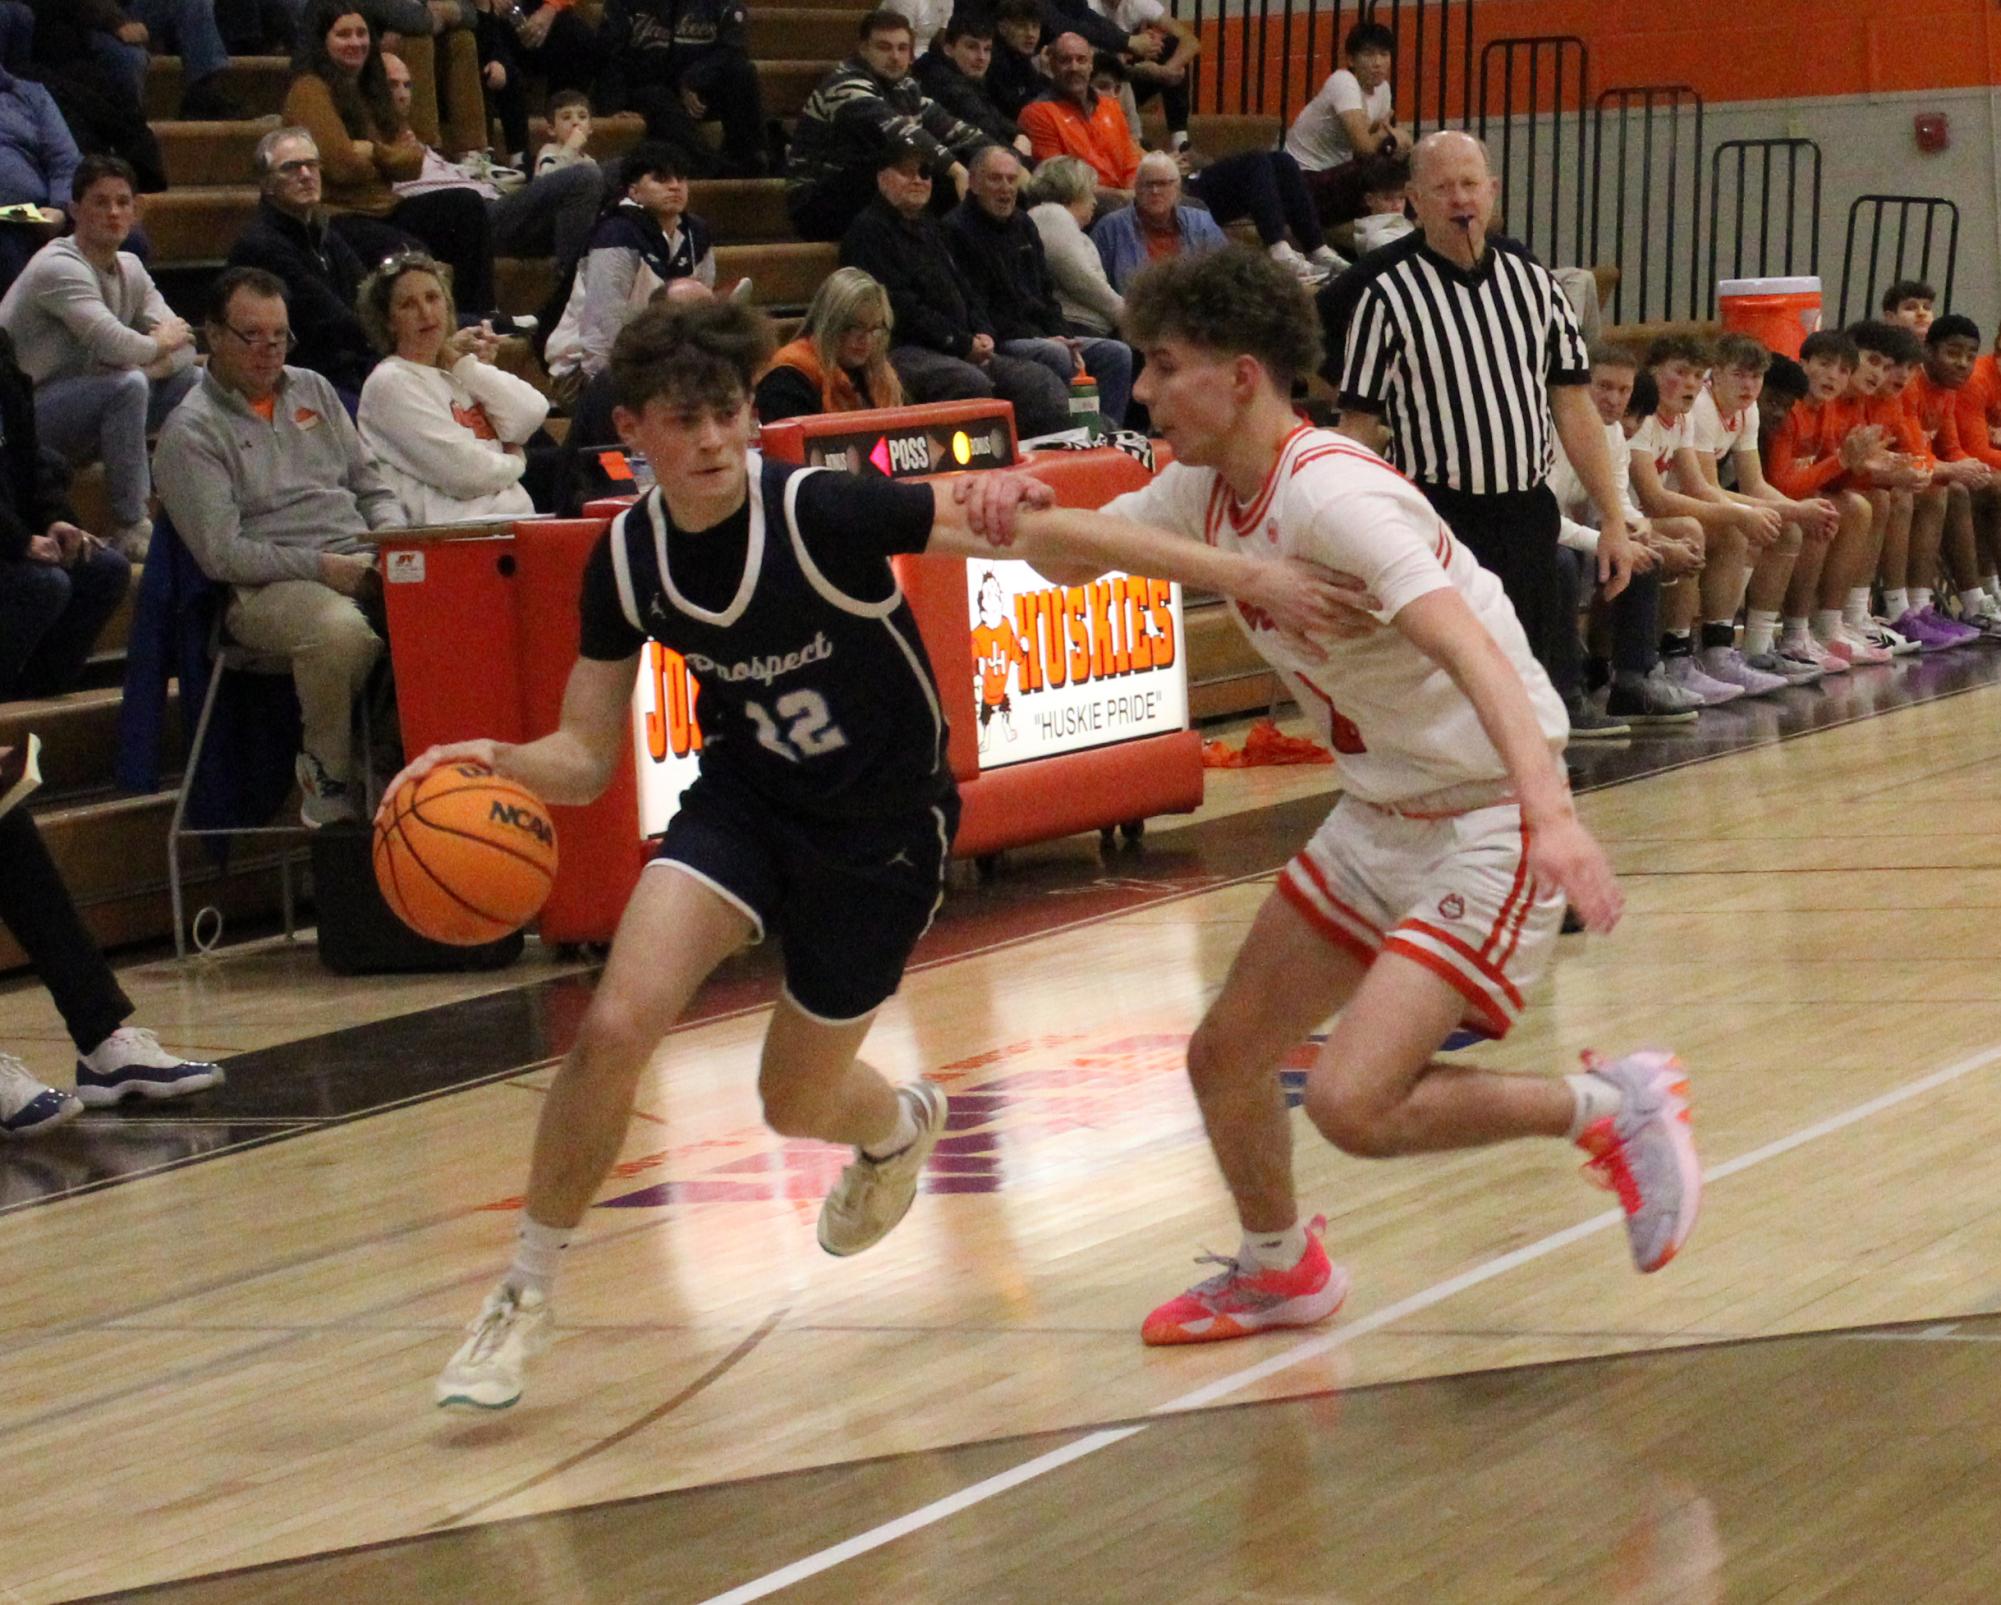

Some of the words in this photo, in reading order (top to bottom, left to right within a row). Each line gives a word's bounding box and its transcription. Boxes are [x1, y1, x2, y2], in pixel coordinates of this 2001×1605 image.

[889, 436, 928, 472] POSS
[684, 630, 833, 686] Prospect
[1014, 575, 1176, 696] HUSKIES
[745, 688, 847, 764] 12
